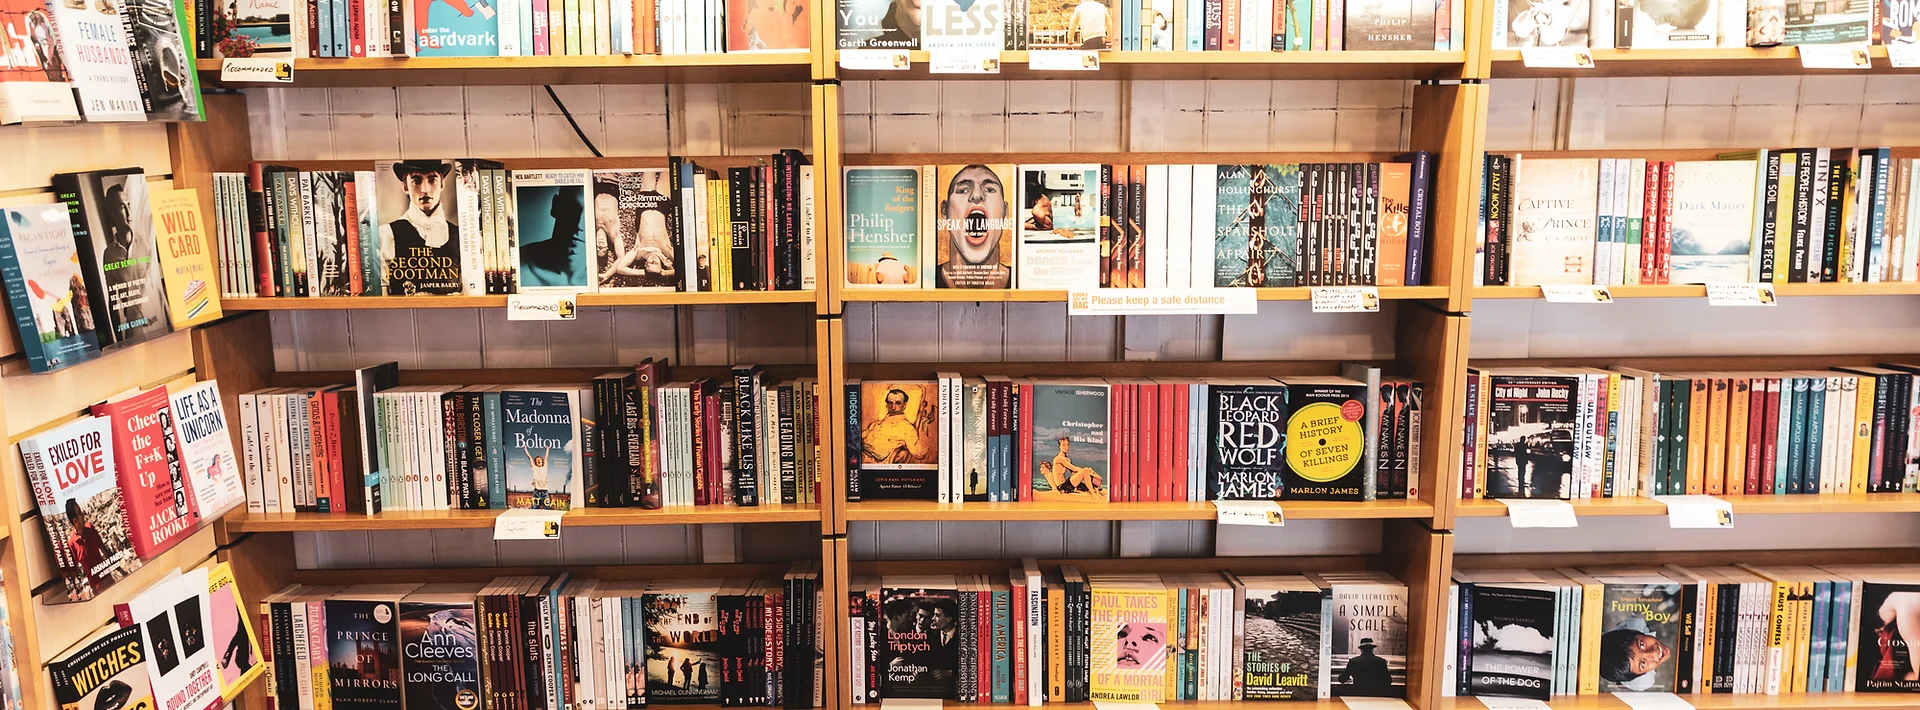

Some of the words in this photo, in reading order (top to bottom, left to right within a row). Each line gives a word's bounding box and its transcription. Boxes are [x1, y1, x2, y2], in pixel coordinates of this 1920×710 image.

[840, 10, 879, 26] You
[926, 5, 998, 37] LESS
[1374, 18, 1407, 26] PHILIP
[78, 21, 117, 42] FEMALE
[420, 31, 496, 47] aardvark
[840, 38, 867, 47] Garth
[870, 38, 917, 47] Greenwell
[76, 44, 128, 65] HUSBANDS
[90, 100, 105, 111] JEN
[109, 100, 139, 112] MANION
[1769, 156, 1779, 181] NIGHT
[896, 186, 914, 195] King
[1219, 186, 1296, 194] HOLLINGHURST
[1767, 185, 1777, 204] SOIL
[885, 204, 914, 213] Badgers
[1218, 205, 1243, 214] THE
[1385, 203, 1409, 213] Kills
[1518, 198, 1574, 211] CAPTIVE
[1680, 201, 1705, 210] Dark
[1709, 201, 1747, 210] Matter
[161, 210, 196, 234] WILD
[850, 214, 893, 231] Philip
[938, 219, 961, 230] SPEAK
[963, 219, 974, 230] MY
[976, 218, 1012, 230] LANGUAGE
[1537, 218, 1590, 231] PRINCE
[850, 228, 915, 243] Hensher
[1218, 226, 1294, 237] SPARSHOLT
[1765, 222, 1775, 246] DALE
[168, 234, 200, 258] CARD
[409, 247, 433, 257] THE
[1217, 249, 1264, 259] AFFAIR
[1763, 248, 1773, 270] PECK
[392, 257, 453, 268] SECOND
[386, 269, 459, 280] FOOTMAN
[1091, 295, 1124, 305] Please
[1126, 295, 1149, 308] keep
[1152, 296, 1158, 304] a
[1161, 295, 1181, 304] safe
[1184, 295, 1225, 304] distance
[117, 323, 129, 332] JOHN
[130, 317, 148, 329] GIORNO
[1495, 388, 1506, 399] City
[1507, 388, 1512, 398] of
[1513, 388, 1528, 399] Night
[1536, 388, 1550, 399] John
[1551, 389, 1569, 400] Rechy
[175, 395, 193, 421] LIFE
[197, 390, 209, 413] AS
[210, 387, 218, 407] A
[530, 398, 543, 406] The
[1219, 395, 1279, 412] BLACK
[127, 411, 161, 433] Cheer
[506, 409, 570, 424] Madonna
[1219, 410, 1279, 423] LEOPARD
[182, 408, 224, 444] UNICORN
[1062, 421, 1104, 429] Christopher
[1301, 422, 1308, 430] A
[1310, 417, 1340, 428] BRIEF
[525, 426, 534, 436] of
[1219, 422, 1278, 449] RED
[1299, 426, 1343, 439] HISTORY
[132, 434, 152, 452] the
[515, 433, 561, 449] Bolton
[48, 438, 80, 466] EXILED
[82, 431, 102, 453] FOR
[1300, 450, 1313, 458] OF
[1316, 444, 1349, 456] SEVEN
[1219, 449, 1277, 466] WOLF
[1303, 454, 1349, 468] KILLINGS
[55, 451, 105, 490] LOVE
[139, 473, 156, 488] Up
[1218, 472, 1276, 484] MARLON
[1218, 483, 1275, 498] JAMES
[1290, 487, 1327, 495] MARLON
[1330, 487, 1359, 495] JAMES
[516, 497, 540, 506] MATT
[544, 498, 566, 507] CAIN
[150, 506, 177, 531] JACK
[152, 516, 190, 546] ROOKE
[1093, 595, 1121, 608] PAUL
[1126, 595, 1158, 608] TAKES
[1611, 601, 1650, 614] Funny
[1030, 591, 1039, 626] FASCINATION
[1339, 605, 1346, 616] A
[1353, 605, 1398, 617] SIMPLE
[1092, 610, 1113, 622] THE
[1116, 610, 1149, 623] FORM
[1646, 610, 1671, 624] Boy
[1350, 619, 1386, 631] SCALE
[337, 631, 389, 642] PRINCE
[421, 630, 456, 645] Ann
[888, 630, 927, 640] London
[405, 643, 474, 659] Cleeves
[888, 641, 930, 654] Triptych
[356, 655, 372, 664] OF
[1246, 652, 1261, 661] THE
[72, 640, 142, 697] WITCHES
[887, 663, 928, 674] Jonathan
[1246, 663, 1279, 672] STORIES
[1281, 663, 1290, 672] OF
[1484, 663, 1505, 673] THE
[1506, 664, 1539, 674] POWER
[335, 678, 398, 689] MIRRORS
[408, 672, 442, 683] LONG
[445, 673, 475, 683] CALL
[889, 673, 914, 684] Kemp
[1098, 674, 1111, 685] OF
[1114, 675, 1121, 685] A
[1123, 675, 1164, 687] MORTAL
[1246, 673, 1273, 687] David
[1276, 673, 1308, 687] Leavitt
[1482, 676, 1496, 685] OF
[1497, 677, 1515, 686] THE
[1518, 678, 1540, 688] DOG
[1091, 692, 1115, 700] ANDREA
[1116, 693, 1140, 701] LAWLOR
[1141, 690, 1164, 701] GIRL
